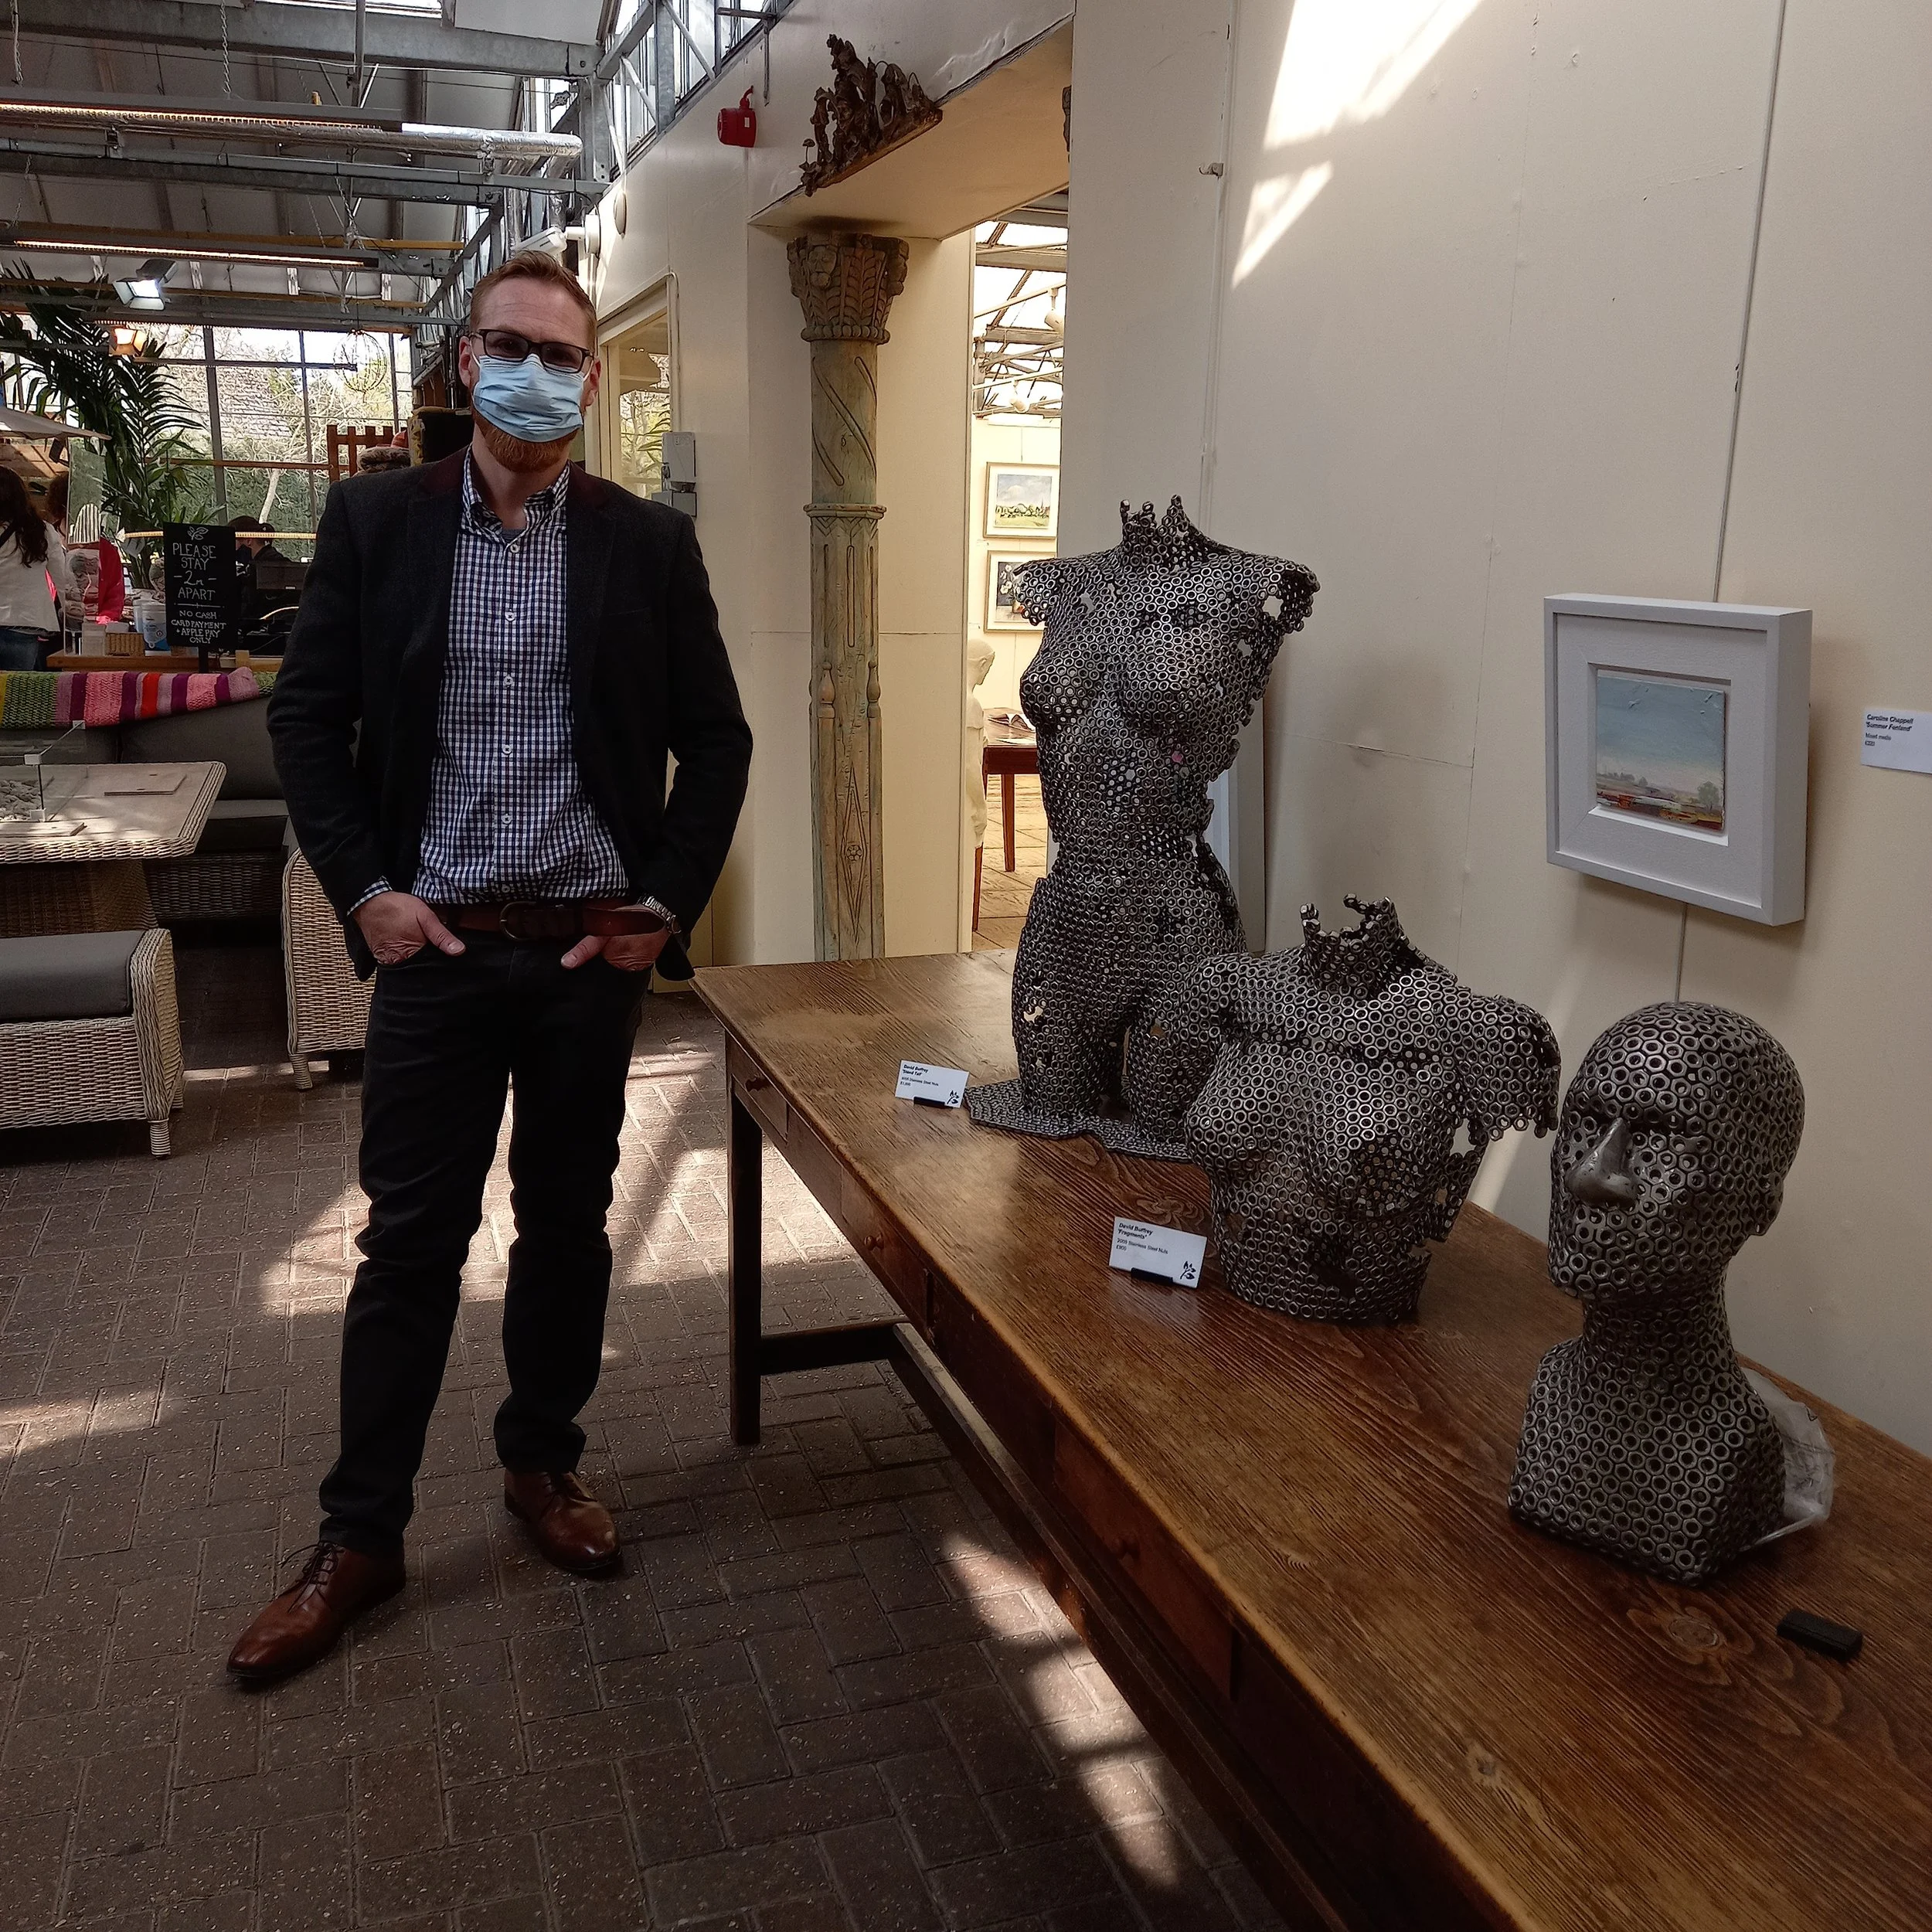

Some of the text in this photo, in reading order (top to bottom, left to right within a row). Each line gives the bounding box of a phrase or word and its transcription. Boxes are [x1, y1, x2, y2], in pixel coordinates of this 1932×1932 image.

[172, 543, 216, 559] PLEASE
[181, 557, 209, 570] STAY
[178, 587, 216, 600] APART
[191, 621, 226, 629] PAYMENT
[181, 628, 204, 637] APPLE
[205, 629, 220, 638] PAY
